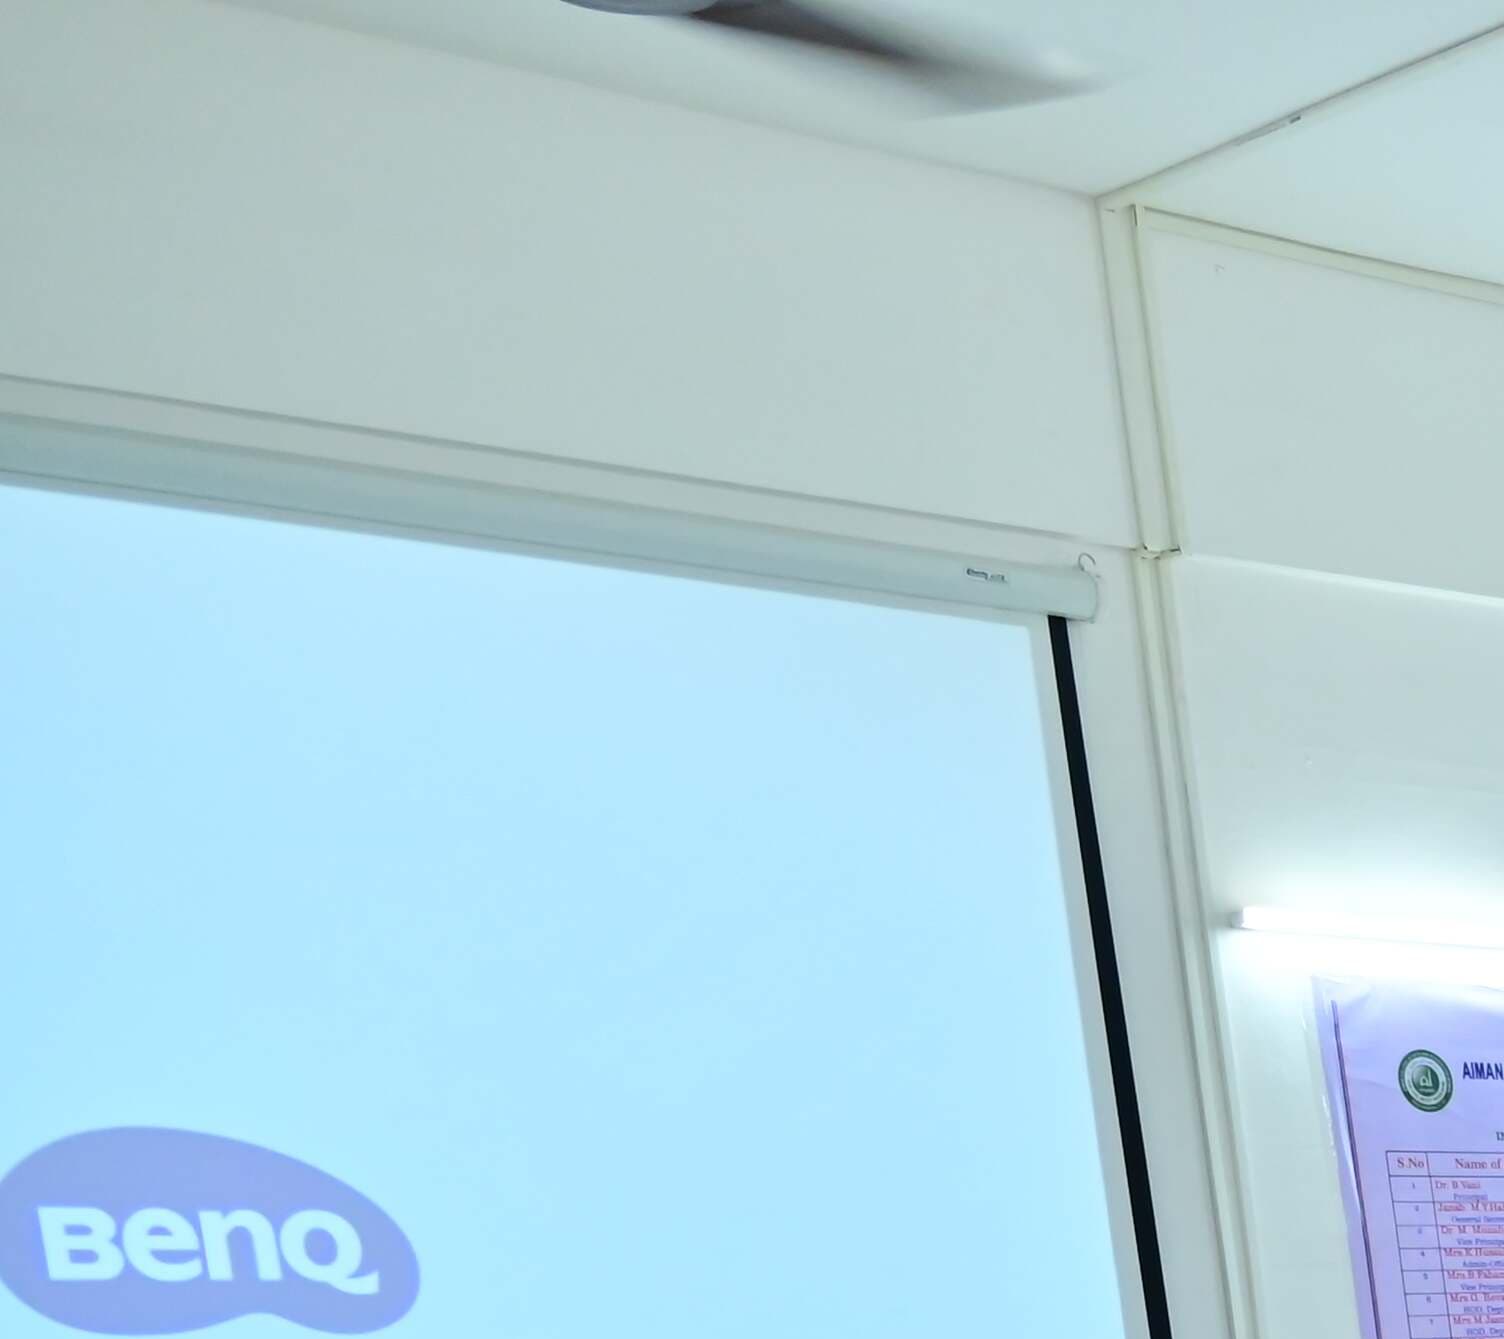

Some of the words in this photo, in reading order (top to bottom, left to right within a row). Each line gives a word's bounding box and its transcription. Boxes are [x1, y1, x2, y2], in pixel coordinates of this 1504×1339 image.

[1463, 1062, 1504, 1080] AIMAN
[1455, 1158, 1488, 1170] Name
[1491, 1158, 1502, 1170] of
[36, 1205, 380, 1295] BenQ
